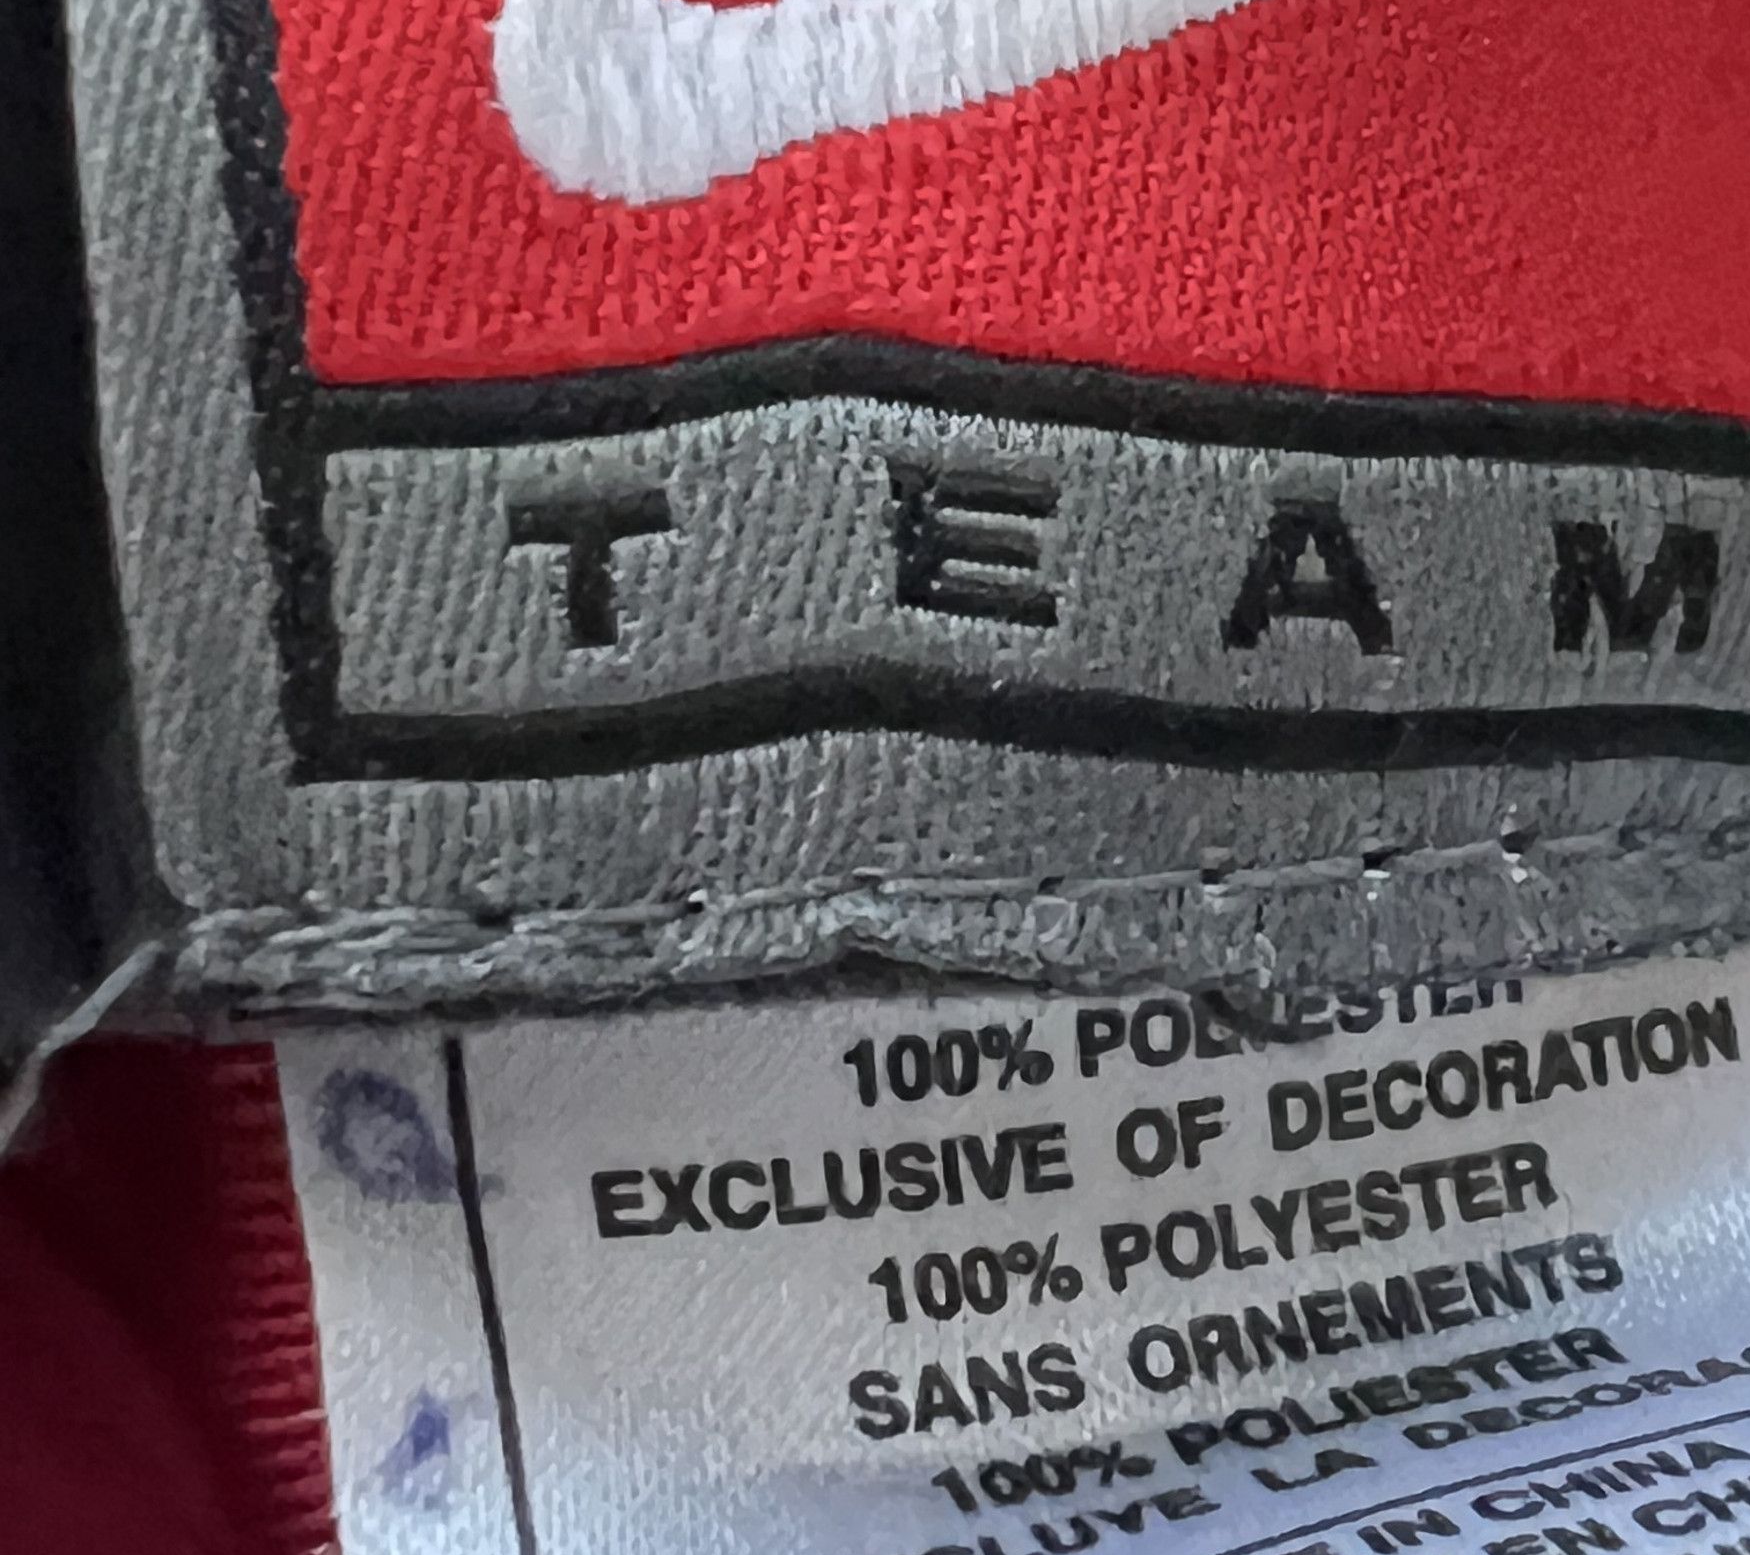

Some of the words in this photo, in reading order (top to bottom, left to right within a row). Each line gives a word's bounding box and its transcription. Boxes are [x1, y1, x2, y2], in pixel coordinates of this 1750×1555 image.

[502, 454, 1724, 659] TEAM
[592, 1122, 1074, 1238] EXCLUSIVE
[1116, 1095, 1226, 1177] OF
[1267, 996, 1741, 1152] DECORATION
[844, 1020, 1054, 1107] 100%
[868, 1232, 1084, 1324] 100%
[1100, 1142, 1557, 1293] POLYESTER
[849, 1343, 1087, 1440] SANS
[1127, 1232, 1625, 1394] ORNEMENTS
[930, 1440, 1157, 1515] 100%
[1165, 1327, 1631, 1465] POLIESTER
[1250, 1448, 1380, 1492] LA
[1356, 1508, 1462, 1555] IN
